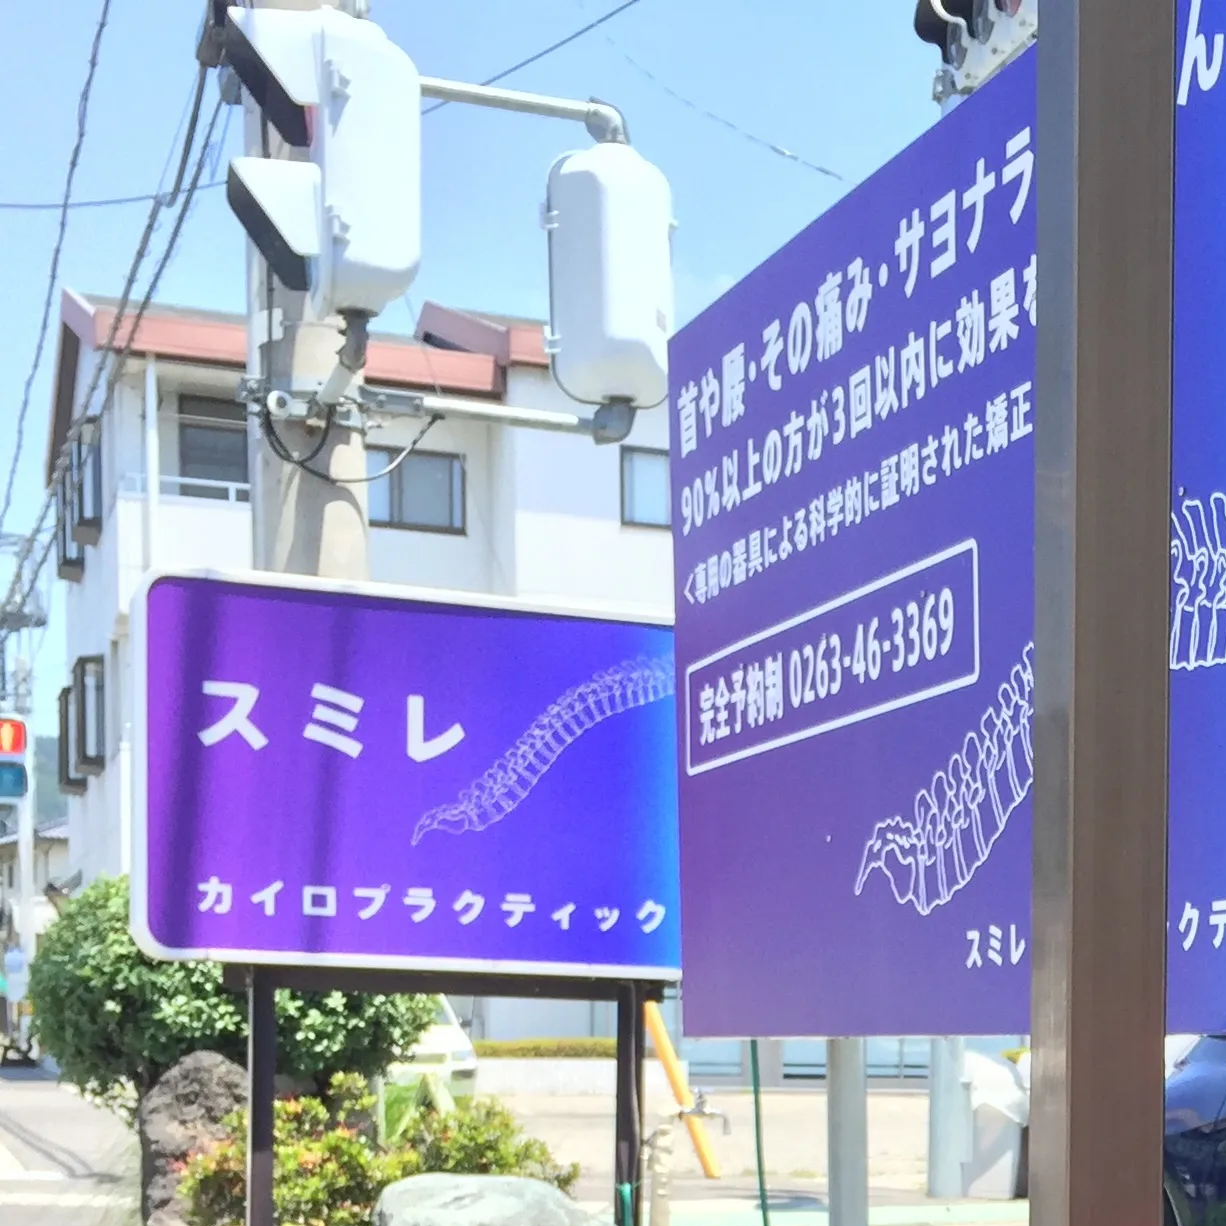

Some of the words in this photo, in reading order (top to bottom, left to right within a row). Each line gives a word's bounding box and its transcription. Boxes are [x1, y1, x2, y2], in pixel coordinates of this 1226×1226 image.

[700, 652, 784, 746] 完全予約制
[789, 588, 954, 709] 0263-46-3369
[197, 680, 466, 762] スミレ
[197, 876, 667, 934] カイロプラクティック
[966, 923, 1027, 969] スミレ
